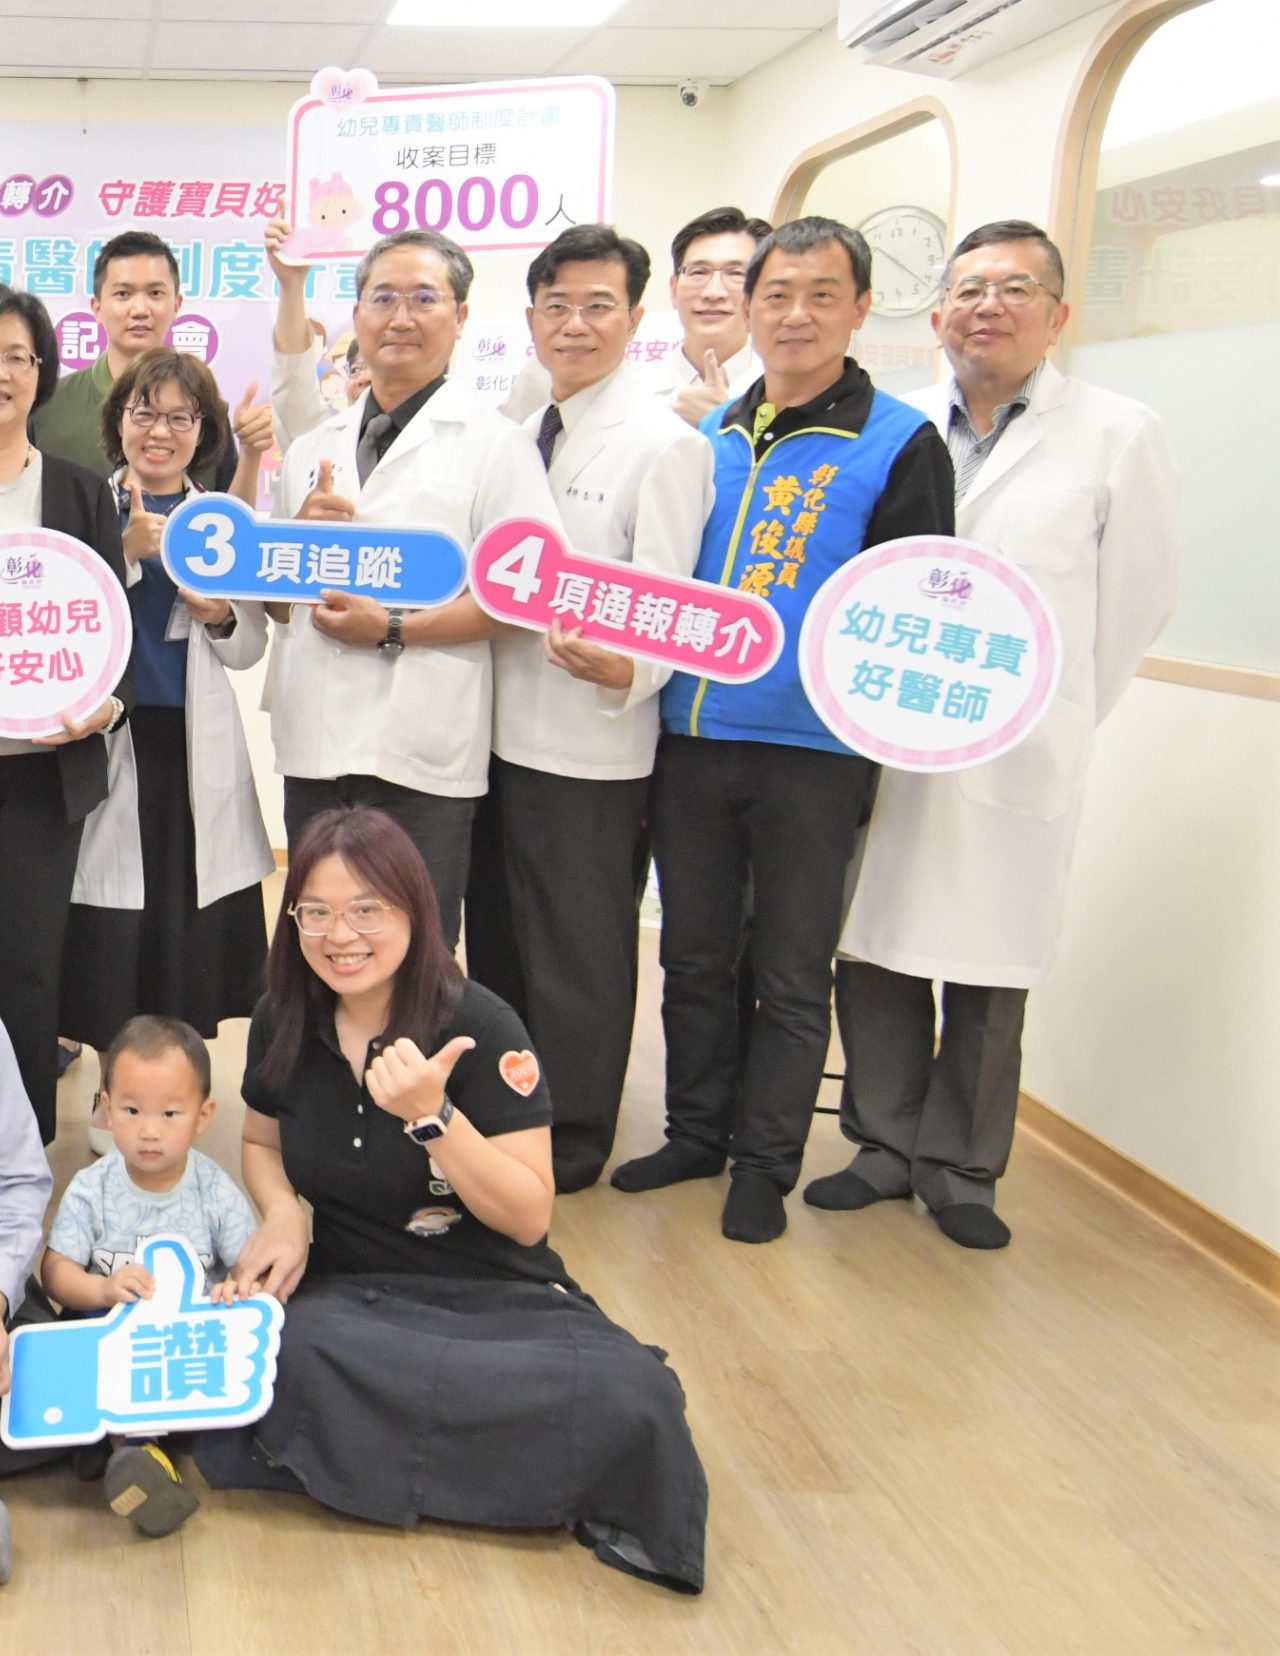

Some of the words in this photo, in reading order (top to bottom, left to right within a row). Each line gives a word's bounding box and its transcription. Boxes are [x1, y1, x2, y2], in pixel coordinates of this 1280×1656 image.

[336, 105, 562, 138] 幼兒專責醫師制度計畫
[396, 143, 497, 170] 收案目標
[475, 375, 518, 392] 彰化
[738, 475, 803, 597] 黃俊源
[776, 463, 839, 589] 彰化縣議員
[5, 554, 44, 578] 彰化
[927, 567, 972, 599] 彰化
[839, 601, 1028, 677] 幼兒專責
[847, 660, 991, 724] 好醫師
[130, 1318, 228, 1403] 讚
